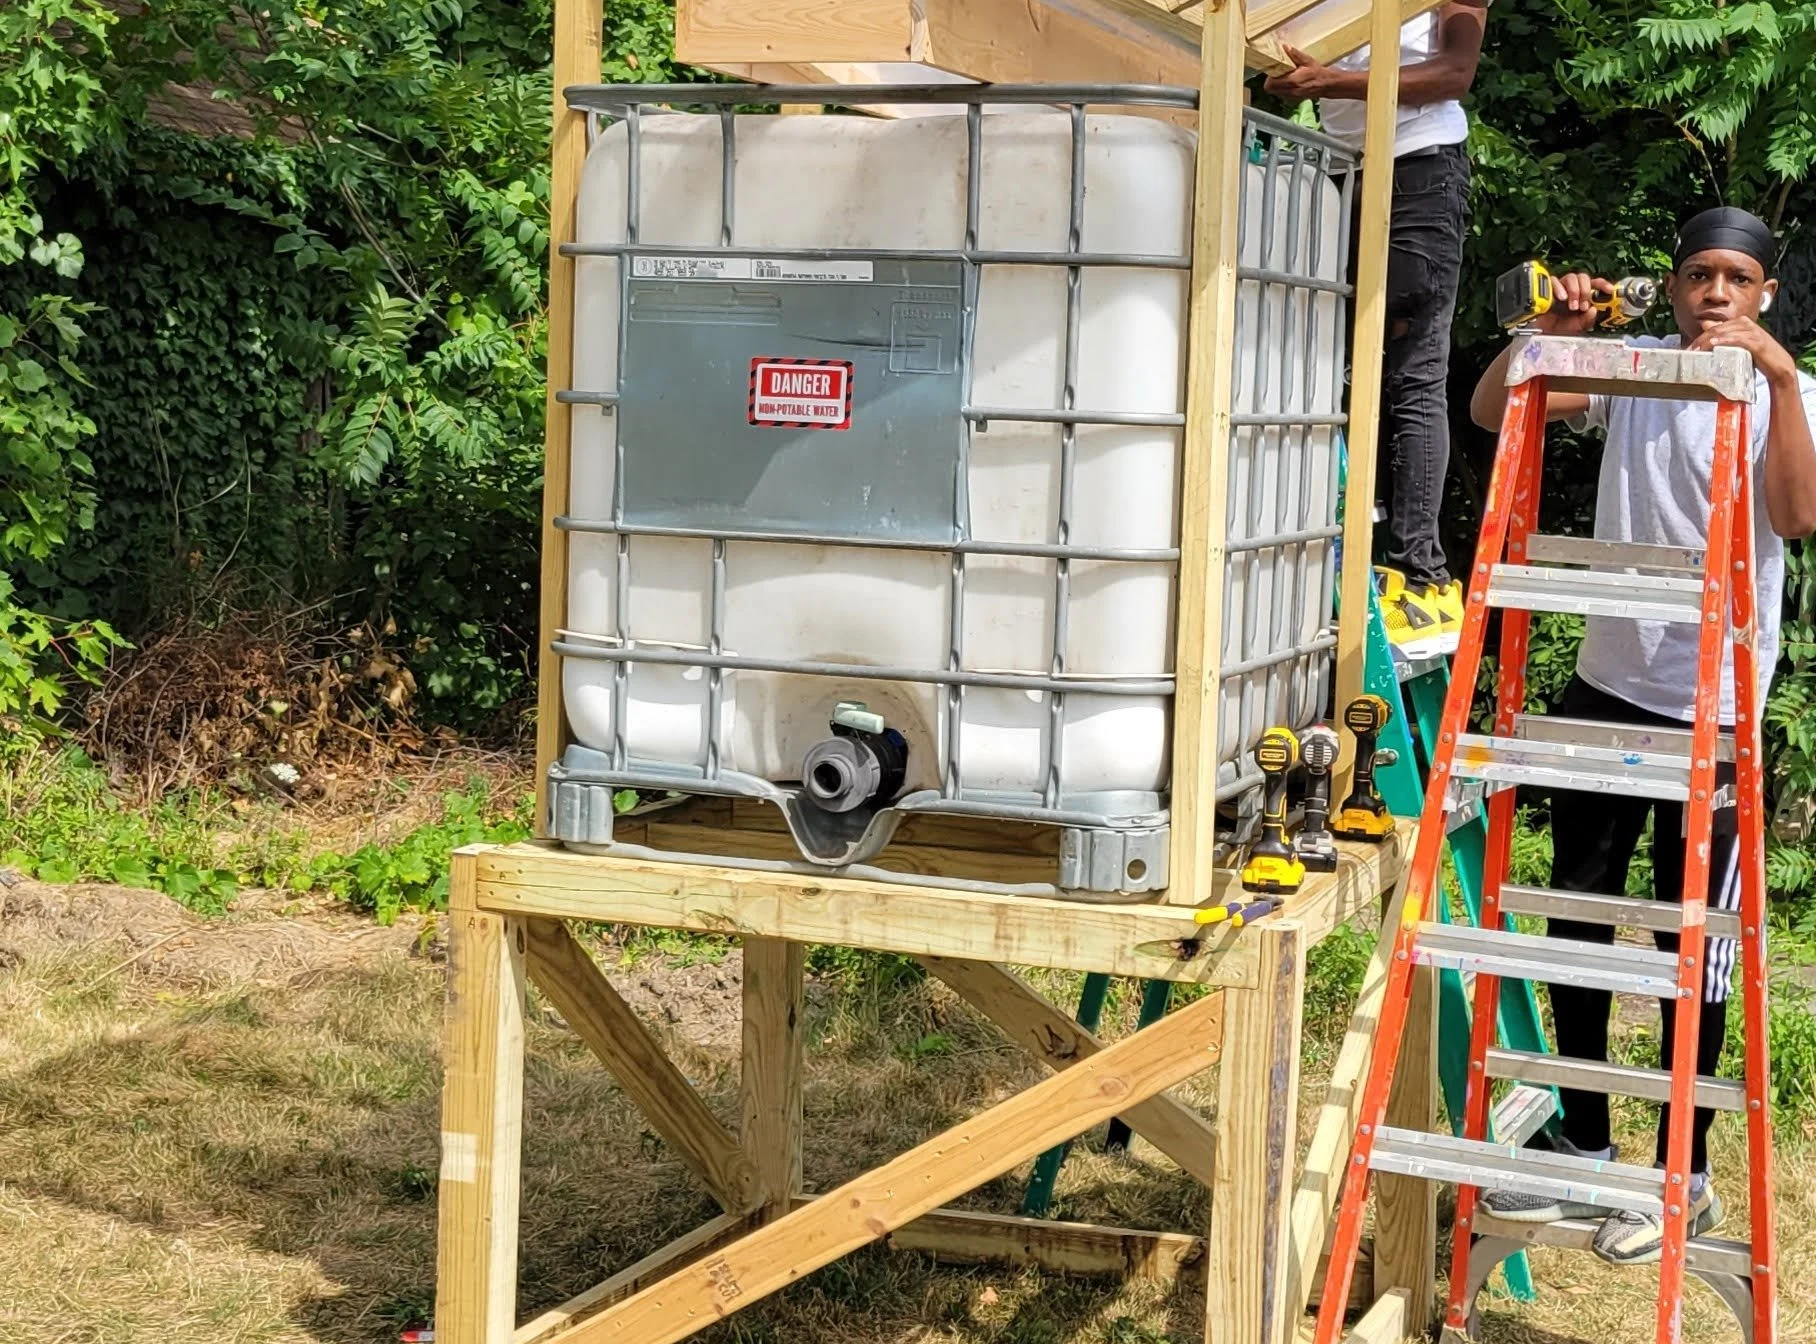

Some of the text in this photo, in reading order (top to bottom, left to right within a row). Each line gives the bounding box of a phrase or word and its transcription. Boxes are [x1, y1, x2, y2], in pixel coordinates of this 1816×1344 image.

[771, 372, 831, 396] DANGER
[758, 402, 839, 417] NON-POTABLE WATER
[467, 916, 476, 930] A
